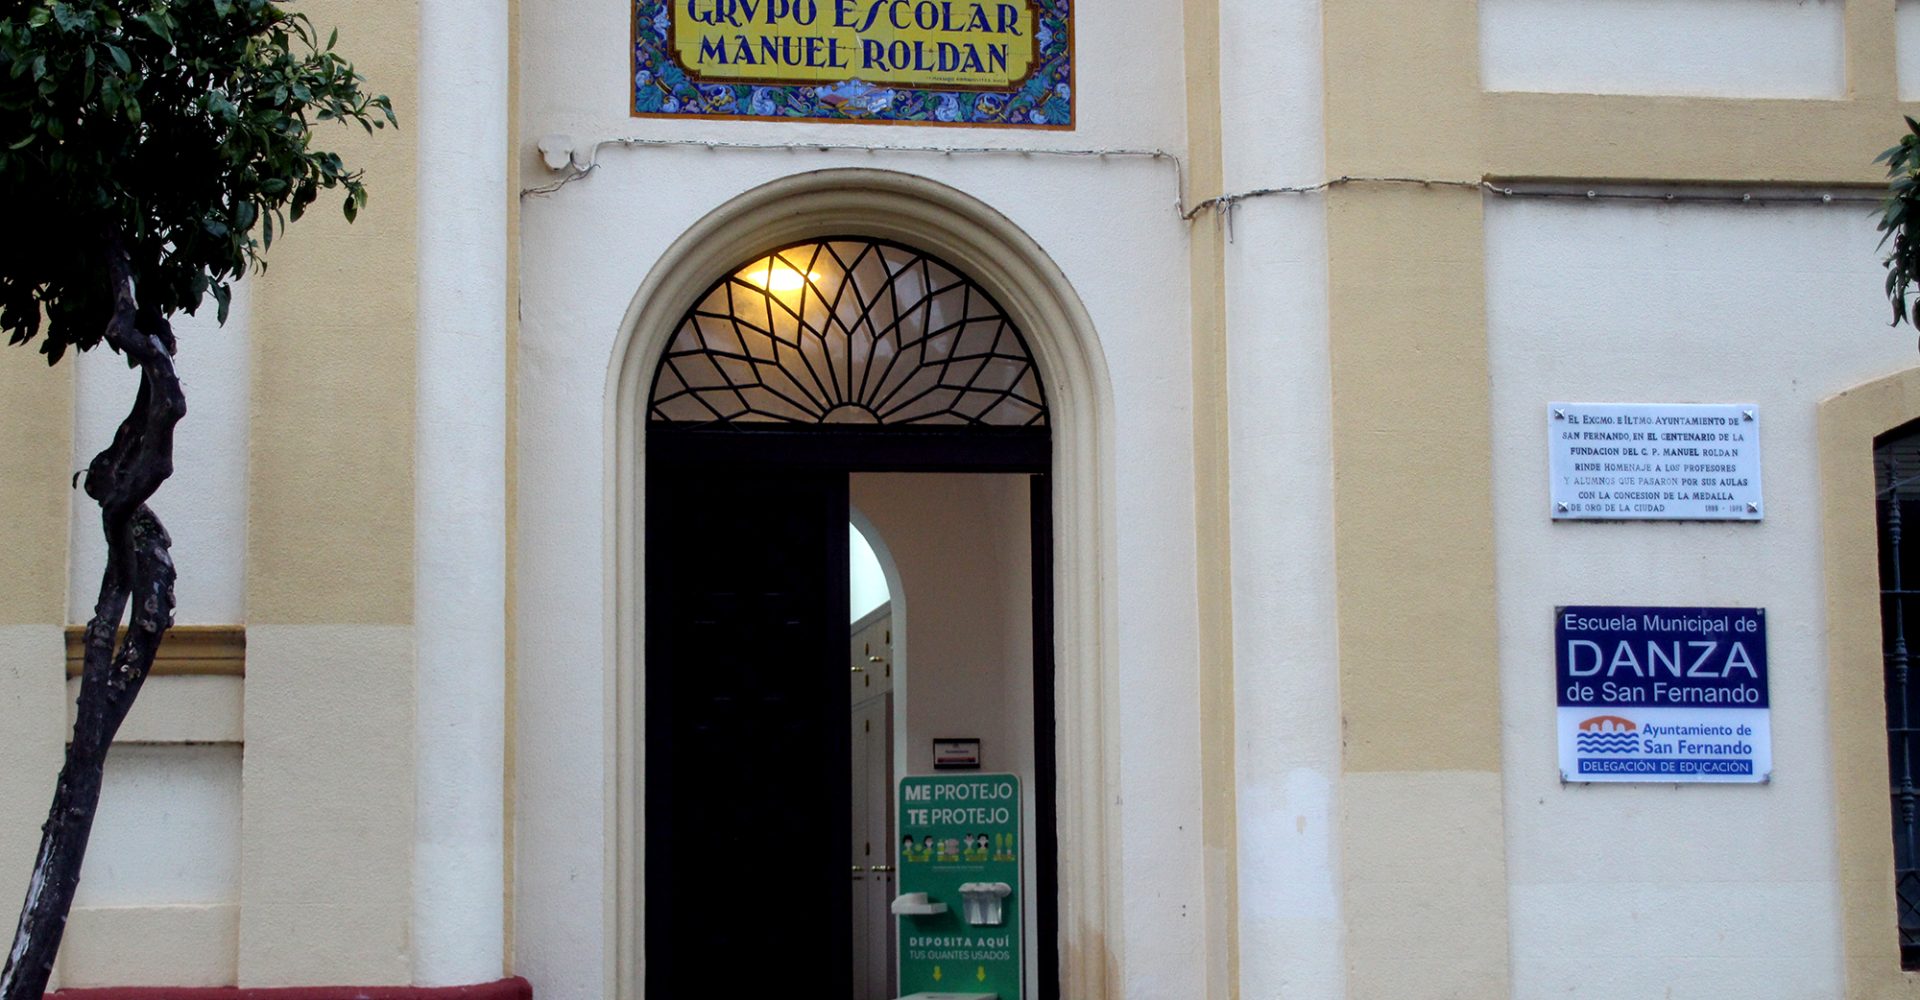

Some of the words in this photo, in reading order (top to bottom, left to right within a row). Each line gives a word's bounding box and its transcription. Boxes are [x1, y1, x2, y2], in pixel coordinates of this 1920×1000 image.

[833, 0, 1023, 36] ESCOLAR
[697, 34, 849, 69] MANUEL
[861, 38, 1008, 73] ROLDAN
[1568, 414, 1579, 424] EL
[1655, 416, 1725, 425] AYUNTAMIENTO
[1729, 417, 1739, 425] DE
[1562, 431, 1580, 440] SAN
[1633, 432, 1644, 440] EN
[1647, 432, 1657, 440] EL
[1661, 432, 1716, 441] CENTENARIO
[1719, 433, 1729, 441] DE
[1732, 433, 1744, 441] LA
[1570, 447, 1619, 455] FUNDACION
[1622, 447, 1638, 455] DEL
[1663, 448, 1699, 456] MANUEL
[1702, 448, 1738, 457] ROLDAN
[1574, 463, 1601, 471] RINDE
[1604, 463, 1651, 472] HOMENAJE
[1655, 464, 1661, 472] A
[1665, 464, 1680, 472] LOS
[1684, 464, 1736, 472] PROFESORES
[1563, 477, 1569, 485] Y
[1574, 477, 1615, 485] ALUMNOS
[1618, 477, 1635, 486] QUE
[1638, 477, 1678, 486] PASARON
[1681, 478, 1698, 486] POR
[1701, 478, 1717, 486] SUS
[1719, 478, 1748, 486] AULAS
[1578, 491, 1595, 499] CON
[1599, 491, 1610, 500] LA
[1614, 491, 1660, 500] CONCESION
[1663, 492, 1674, 500] DE
[1677, 492, 1689, 500] LA
[1692, 492, 1734, 500] MEDALLA
[1571, 503, 1581, 511] DE
[1585, 503, 1602, 511] ORO
[1605, 504, 1615, 512] DE
[1619, 503, 1630, 512] LA
[1634, 503, 1665, 512] CIUDAD
[1564, 613, 1637, 632] Escuela
[1643, 614, 1729, 635] Municipal
[1734, 616, 1757, 632] de
[1567, 639, 1758, 678] DANZA
[1566, 681, 1594, 702] de
[1602, 681, 1645, 702] San
[1653, 682, 1759, 703] Fernando
[1642, 723, 1732, 738] Ayuntamiento
[1736, 724, 1752, 736] de
[1643, 739, 1673, 754] San
[1678, 740, 1752, 755] Fernando
[1582, 759, 1656, 772] DELEGACIÓN
[1660, 761, 1675, 772] DE
[1680, 760, 1749, 773] EDUCACIÓN
[905, 785, 931, 801] ME
[934, 783, 1012, 800] PROTEJO
[907, 808, 928, 825] TE
[931, 807, 1009, 824] PROTEJO
[909, 937, 972, 947] DEPOSITA
[977, 935, 1009, 948] AQUÍ
[910, 950, 926, 959] TUS
[928, 950, 969, 960] GUANTES
[971, 950, 1010, 960] USADOS
